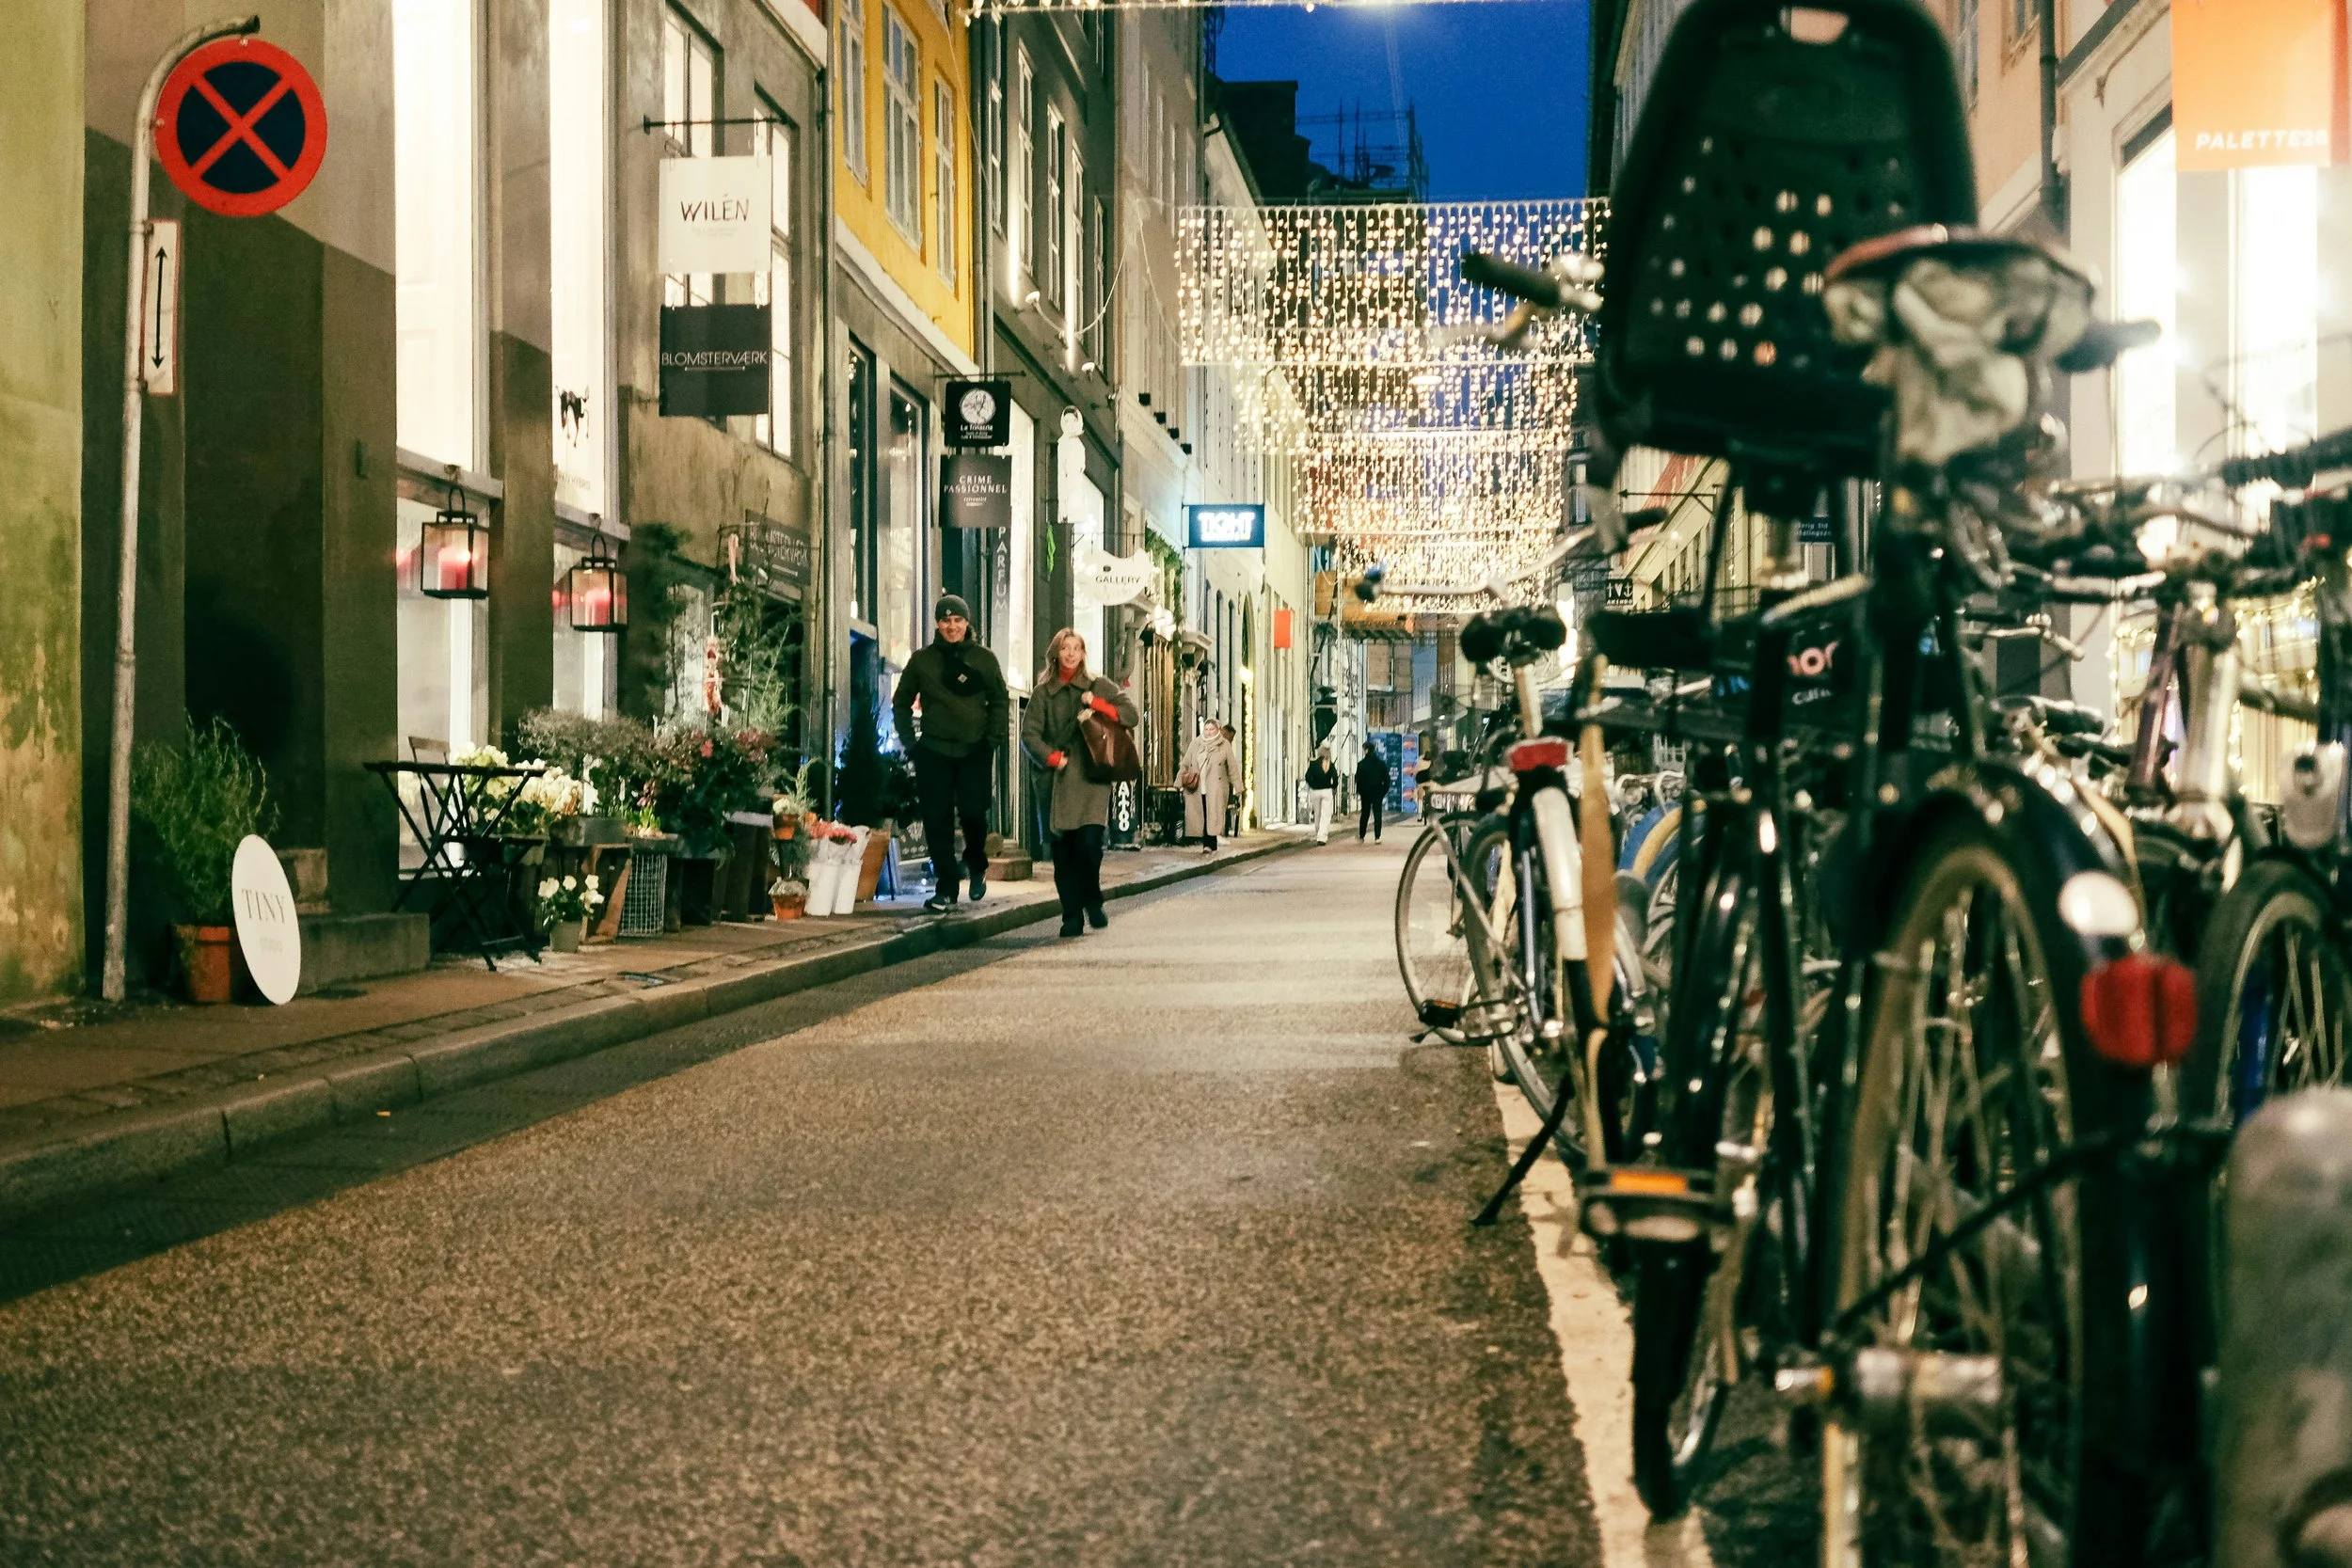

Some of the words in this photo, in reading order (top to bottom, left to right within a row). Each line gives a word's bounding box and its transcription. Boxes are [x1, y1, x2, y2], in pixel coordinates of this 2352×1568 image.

[679, 192, 750, 222] WILÉN
[661, 350, 768, 367] BLOMSTERVÆRK
[959, 475, 993, 484] CRIME
[944, 484, 1008, 494] PASSIONNEL
[1095, 575, 1141, 584] GALLERY
[241, 888, 285, 925] TINY
